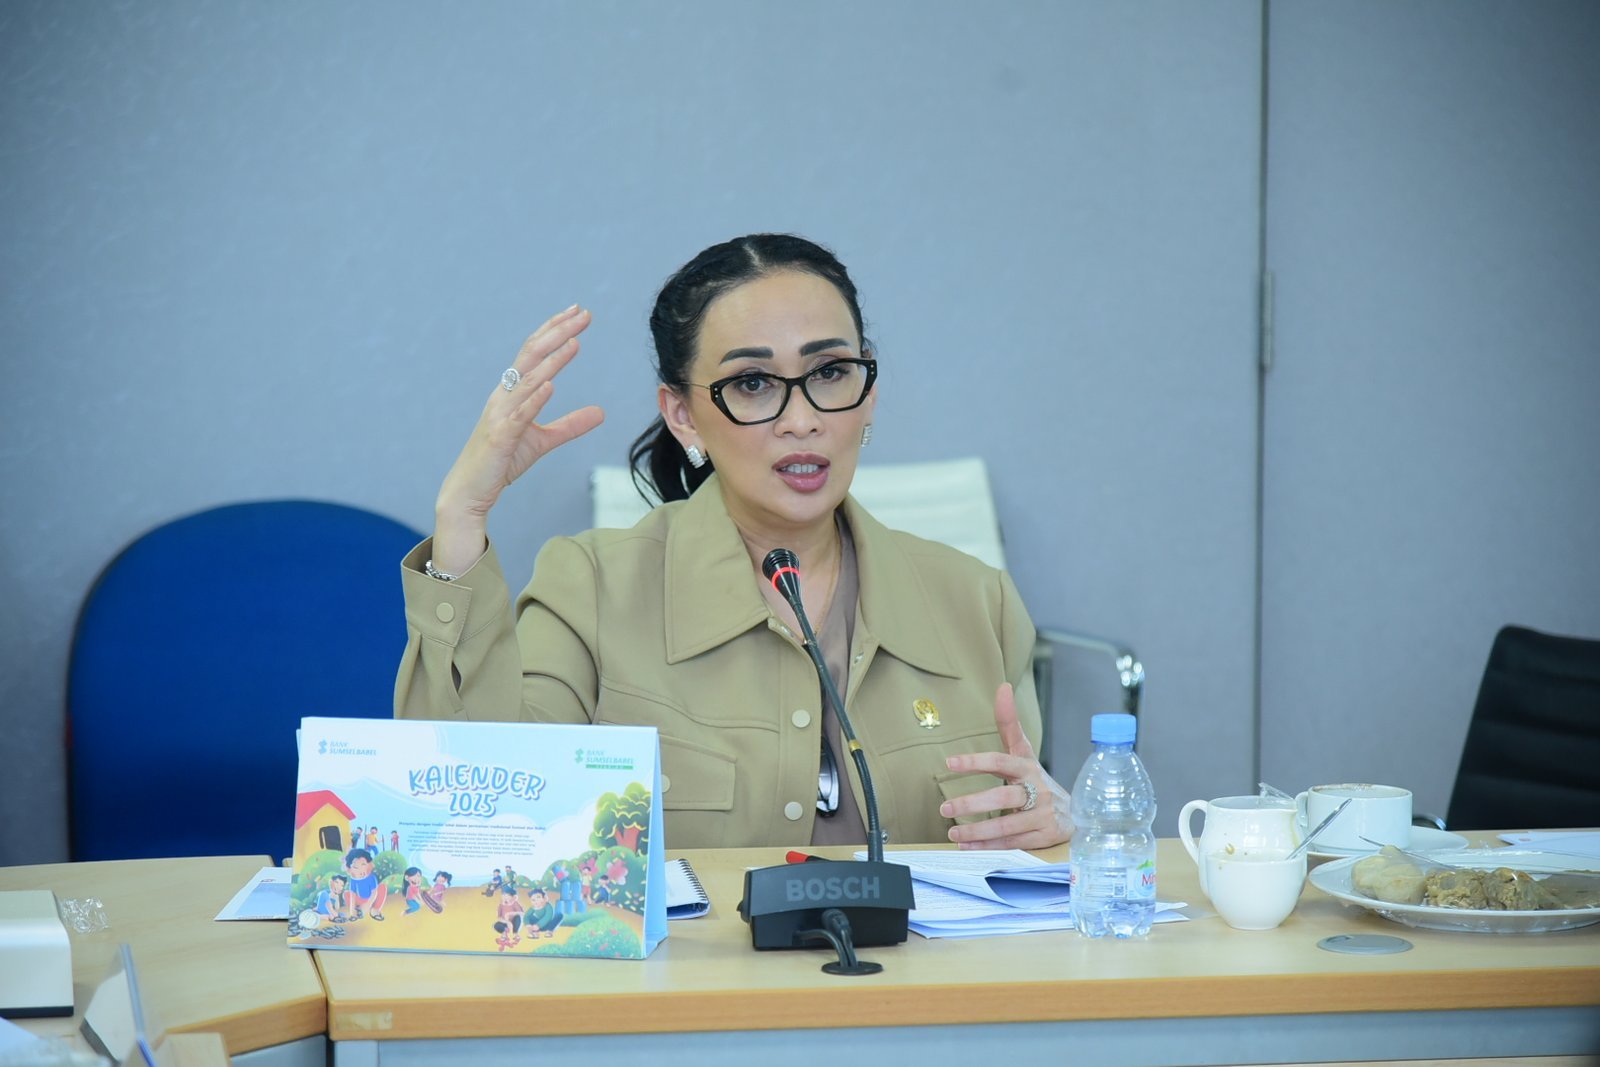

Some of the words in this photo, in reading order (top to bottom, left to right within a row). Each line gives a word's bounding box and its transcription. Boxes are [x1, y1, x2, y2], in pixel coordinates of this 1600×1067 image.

[408, 764, 544, 798] KALENDER
[449, 792, 496, 815] 2025
[786, 876, 880, 901] BOSCH
